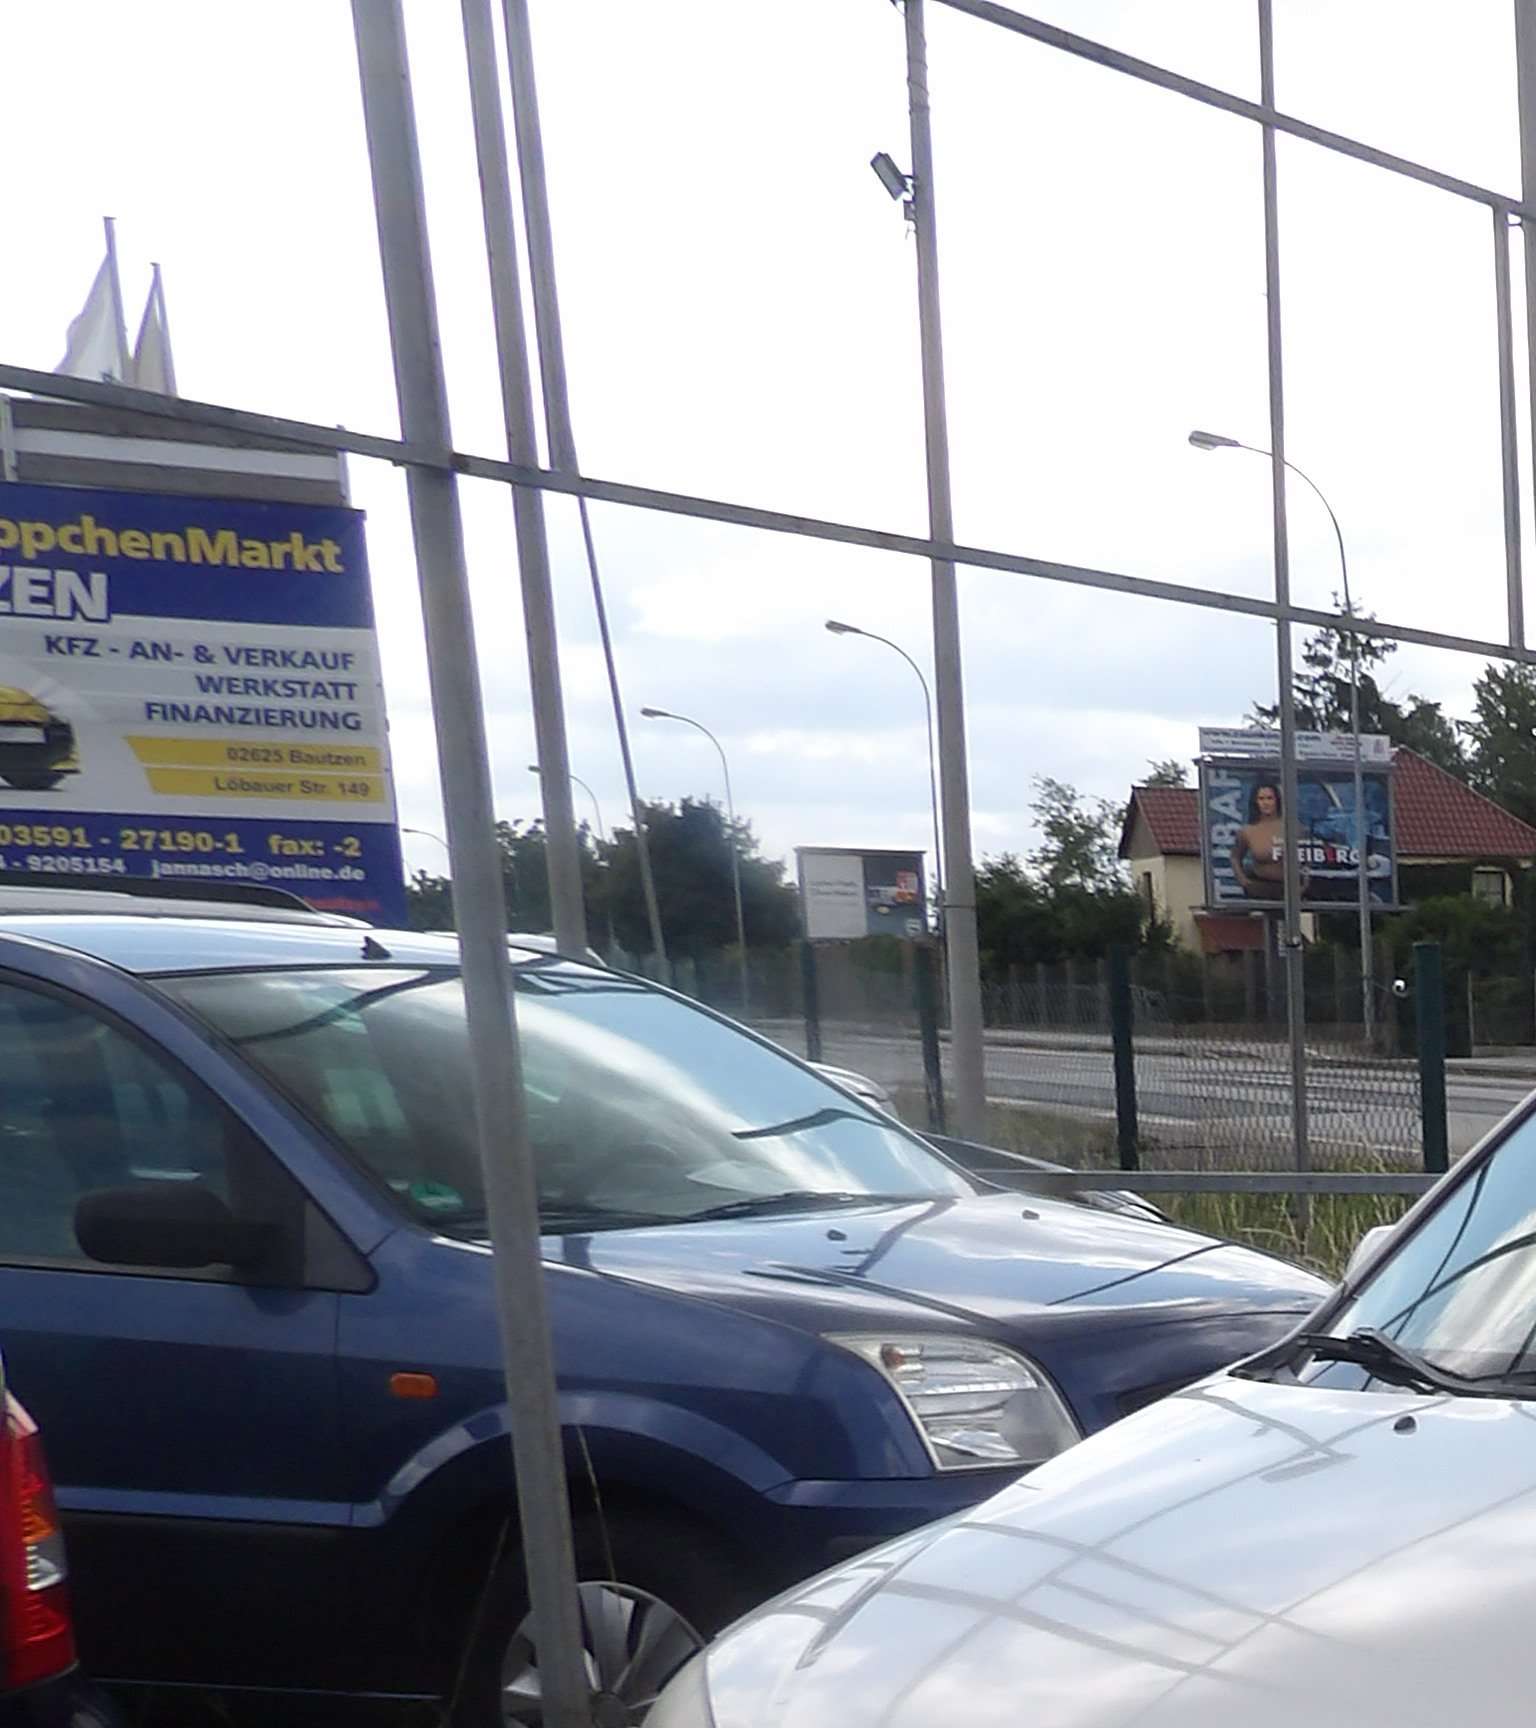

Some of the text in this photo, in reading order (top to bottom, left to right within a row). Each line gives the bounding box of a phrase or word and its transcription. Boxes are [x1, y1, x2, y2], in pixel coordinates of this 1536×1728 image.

[44, 635, 101, 657] KFZ
[129, 641, 184, 662] AN-
[193, 645, 216, 664] &
[223, 646, 355, 671] VERKAUF
[195, 675, 358, 700] WERKSTATT
[145, 702, 362, 730] FINANZIERUNG
[226, 747, 367, 767] 02625 Bautzen
[338, 781, 369, 797] 149
[0, 824, 93, 849] 03591
[120, 829, 245, 853] 27190-1
[267, 834, 324, 856] fax:
[333, 836, 362, 858] -2
[26, 854, 127, 874] 9205154
[151, 860, 366, 881] jannasch@online.de
[1272, 846, 1361, 864] FEIBRG
